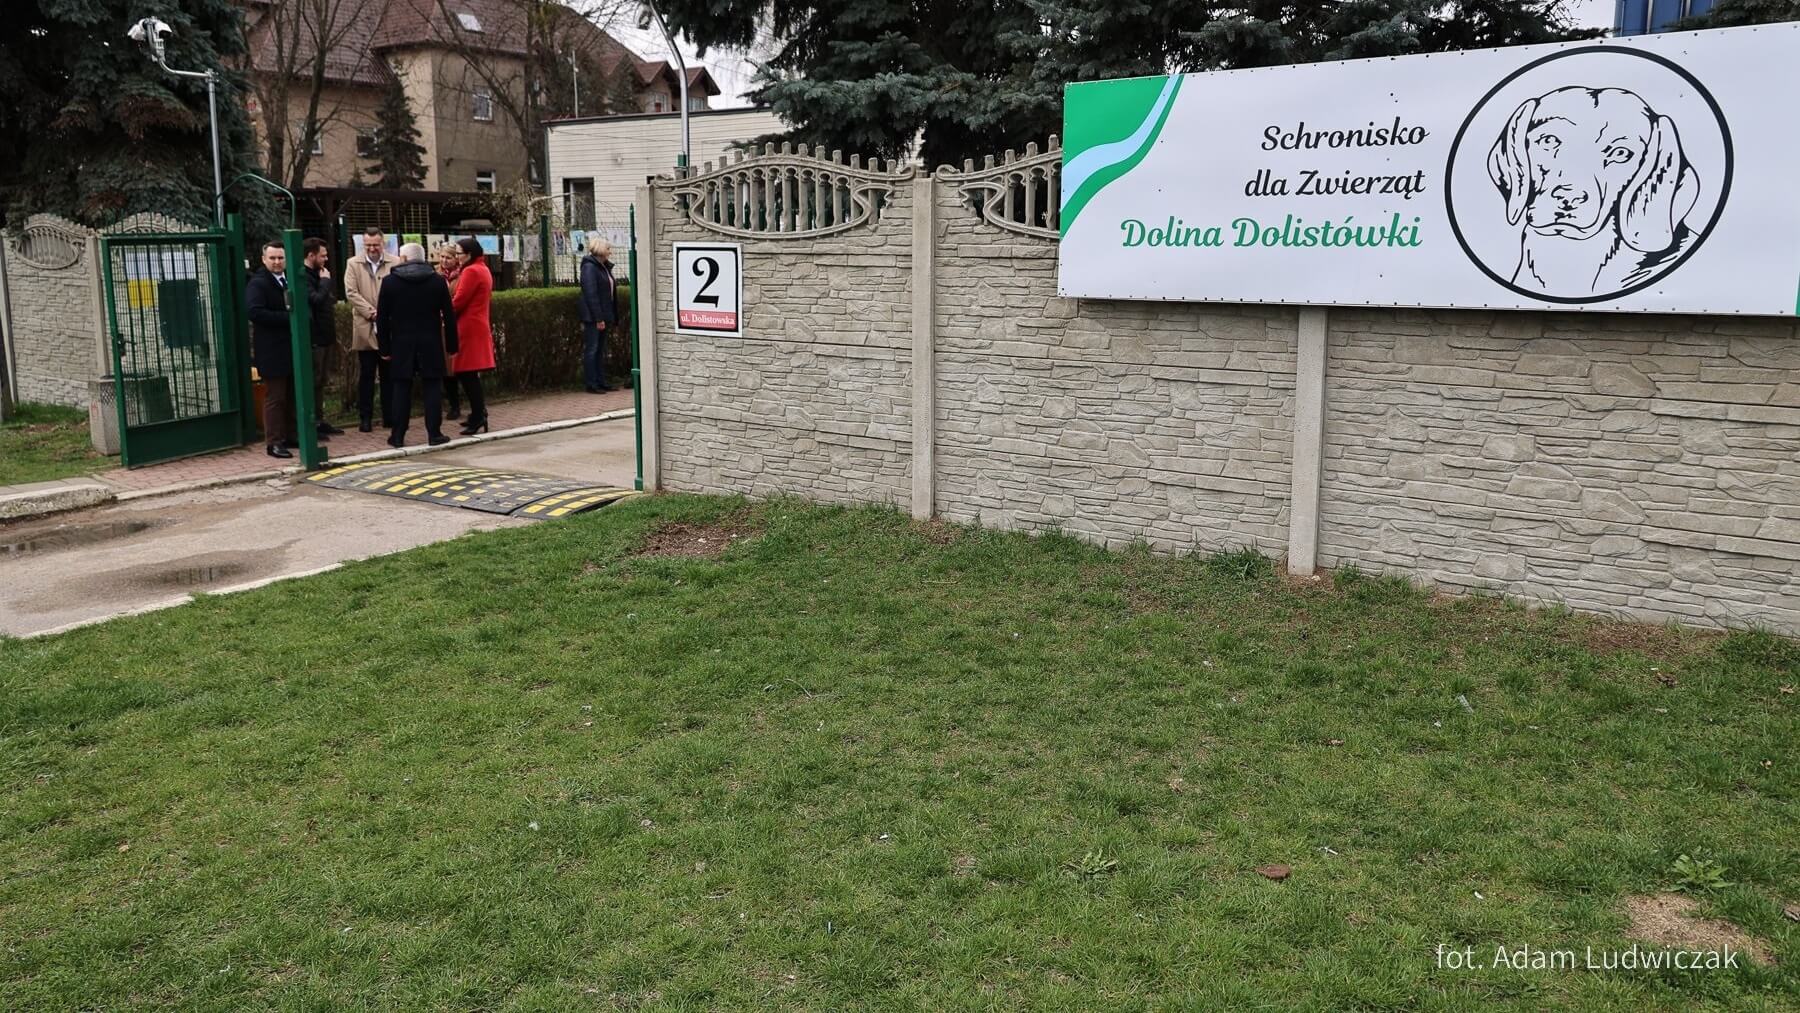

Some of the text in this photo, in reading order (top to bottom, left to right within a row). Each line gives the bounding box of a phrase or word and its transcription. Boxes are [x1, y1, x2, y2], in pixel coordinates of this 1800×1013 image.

[1261, 117, 1430, 151] Schronisko
[1244, 169, 1426, 200] dla Zwierząt
[1120, 212, 1422, 248] Dolina Dolistówki
[692, 256, 719, 308] 2
[681, 313, 735, 325] ul. Dolistowska
